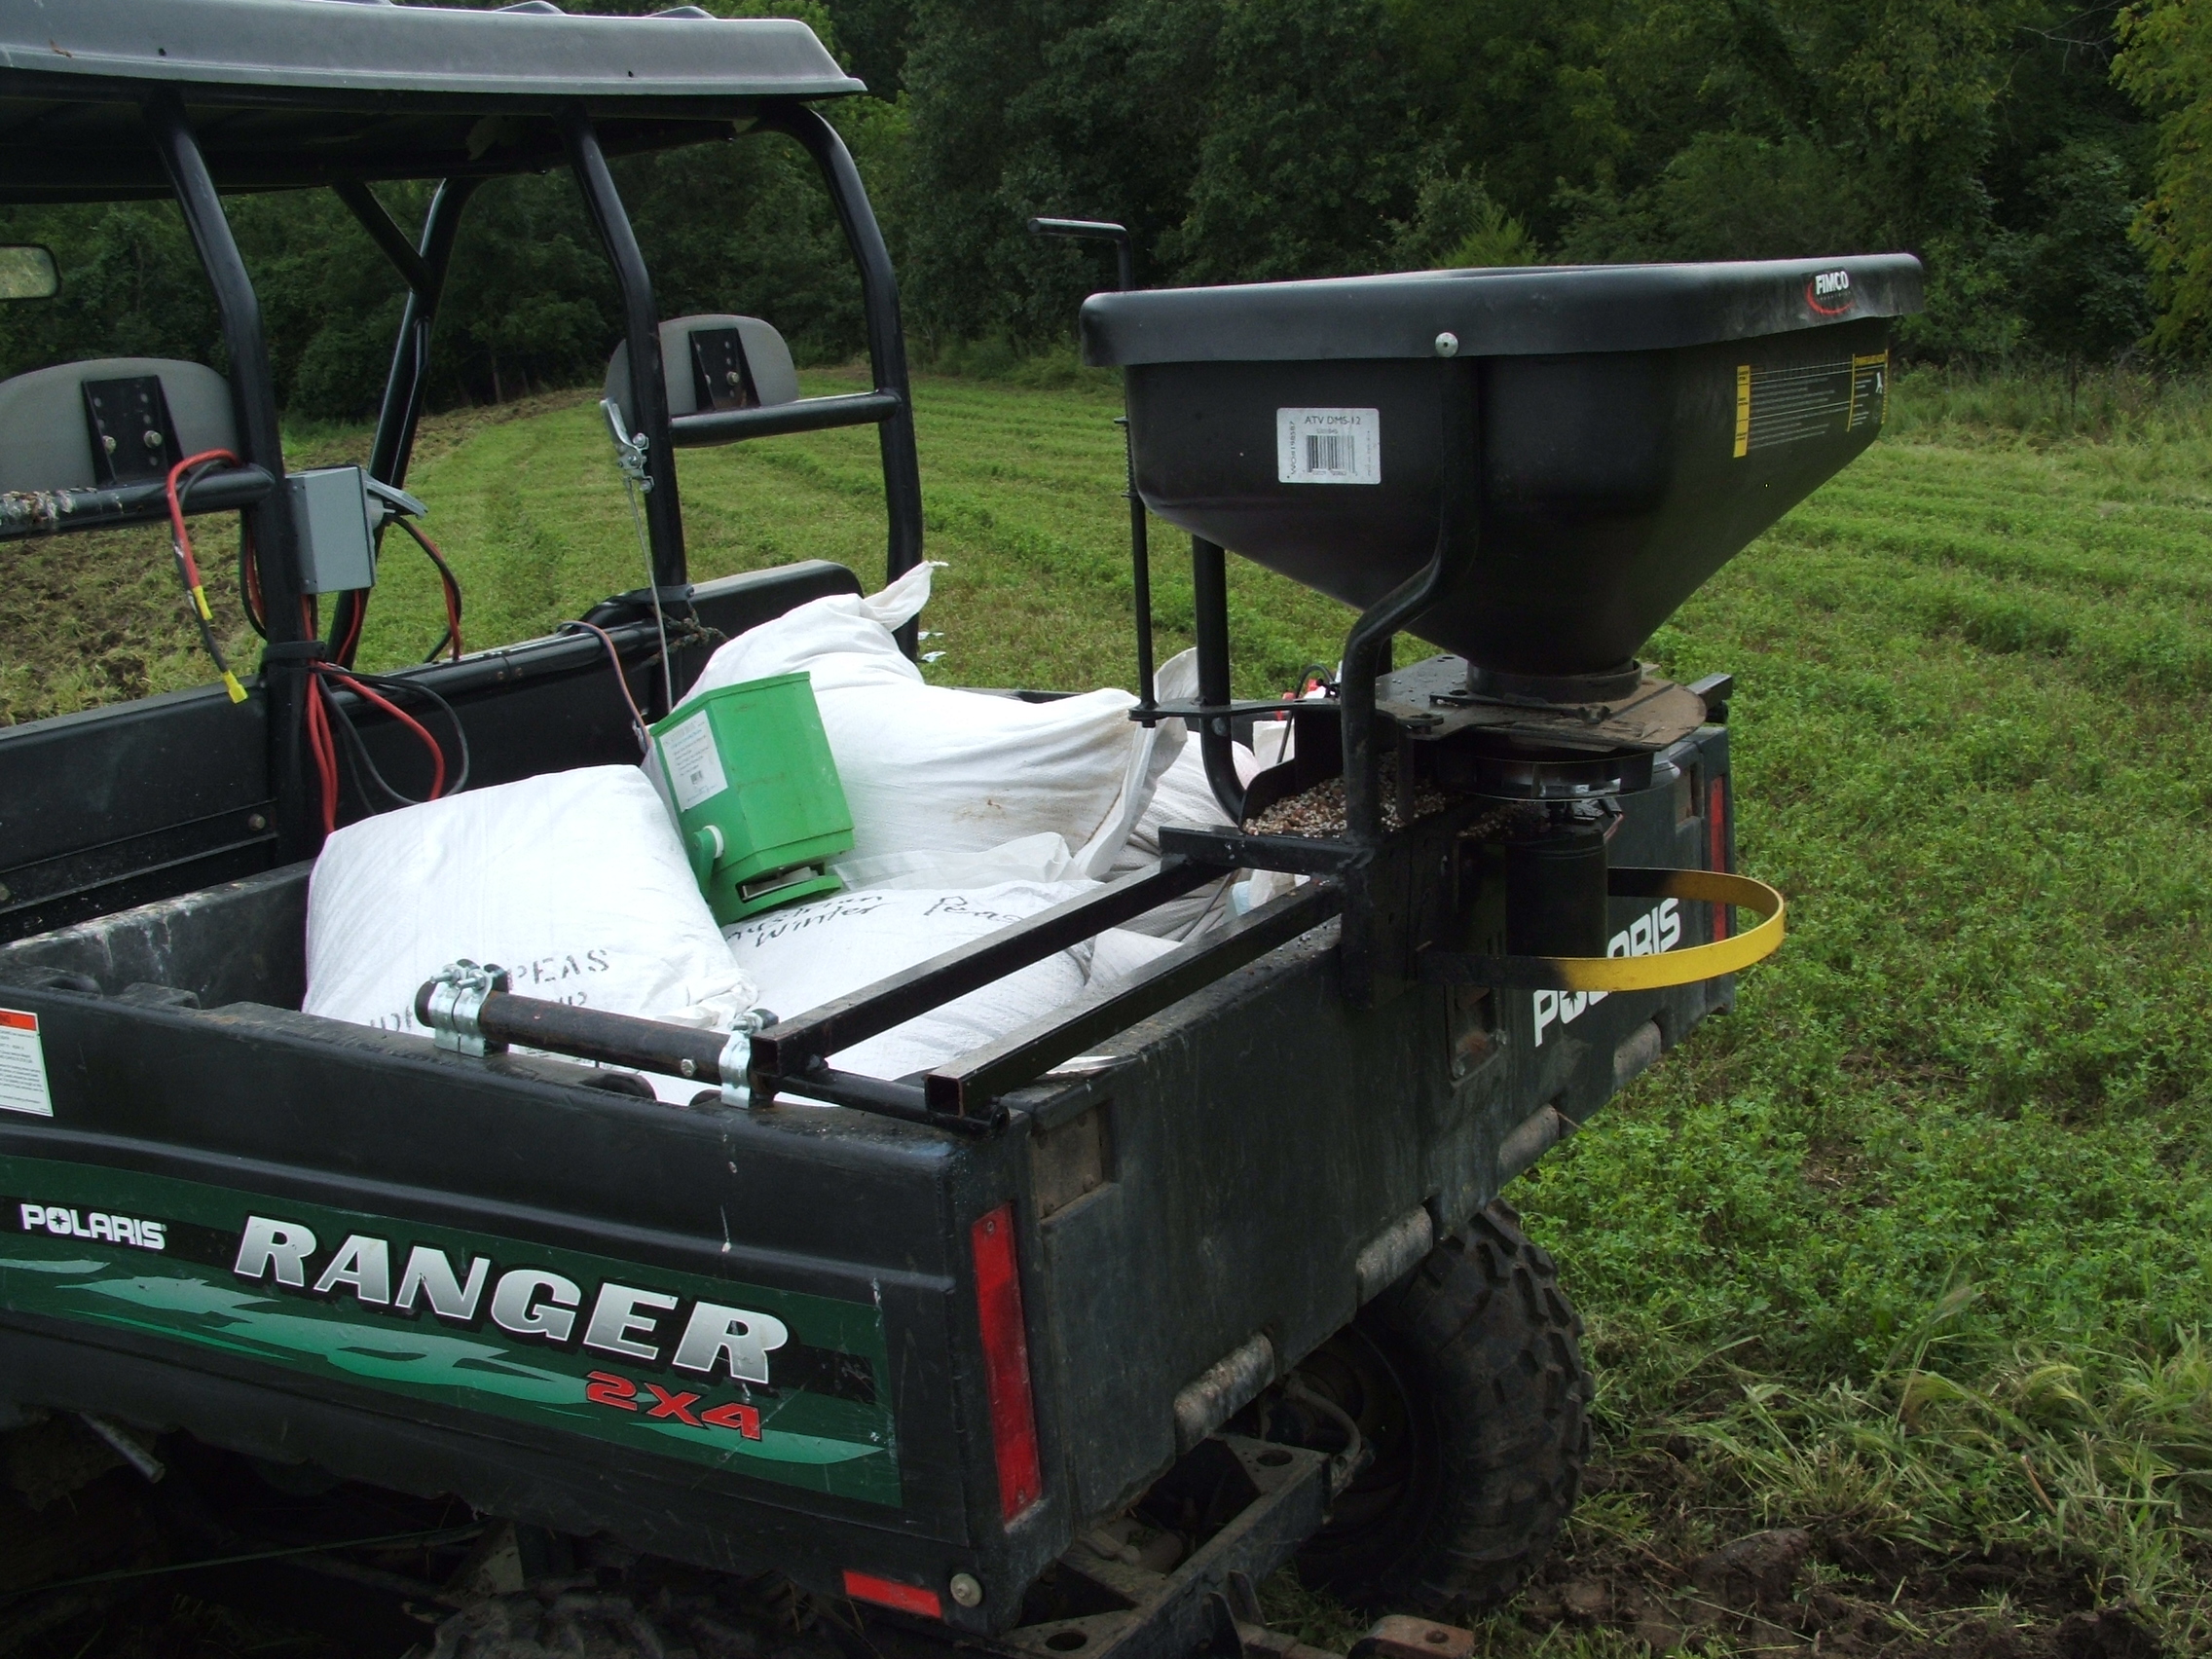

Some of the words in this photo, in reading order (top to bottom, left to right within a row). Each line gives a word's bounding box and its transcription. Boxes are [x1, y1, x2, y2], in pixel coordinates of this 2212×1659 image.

[1815, 270, 1850, 296] FIMCO
[1304, 415, 1324, 425] ATV
[756, 902, 885, 947] Winter
[20, 1203, 166, 1250] POLARIS
[235, 1215, 788, 1384] RANGER
[584, 1371, 762, 1440] 2X4
